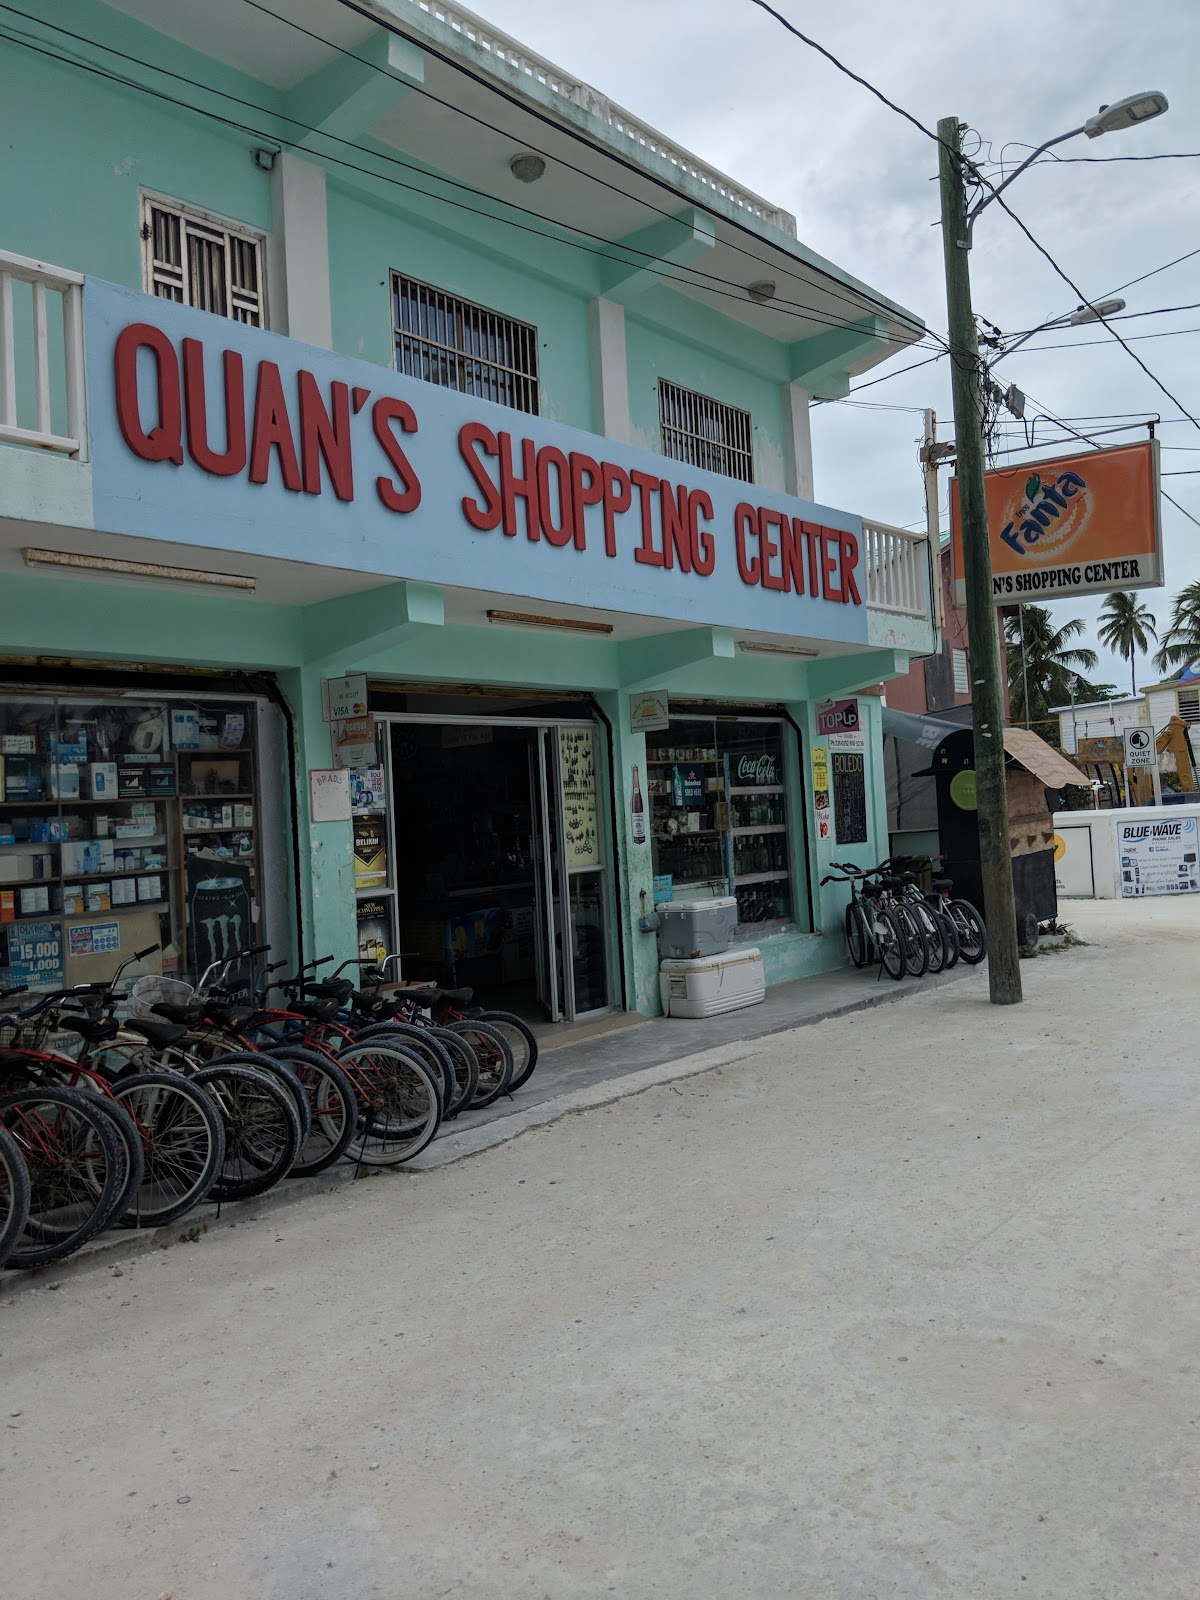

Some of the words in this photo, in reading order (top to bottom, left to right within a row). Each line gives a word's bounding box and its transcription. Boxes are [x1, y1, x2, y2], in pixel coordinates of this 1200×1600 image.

[114, 322, 421, 513] QUAN'S
[458, 422, 715, 576] SHOPPING
[735, 502, 861, 605] CENTER
[1000, 471, 1086, 555] Fanta
[1015, 567, 1082, 591] SHOPPING
[1084, 559, 1140, 584] CENTER
[333, 705, 350, 715] VISA
[834, 755, 862, 773] BOLEDO
[316, 775, 342, 786] BRADS
[1123, 825, 1151, 839] BLUE
[1152, 823, 1182, 836] WAVE
[356, 837, 378, 847] BELIKIN
[72, 927, 91, 936] CASH
[20, 941, 59, 960] 15,000
[29, 958, 60, 973] 1,000
[26, 973, 41, 982] 500
